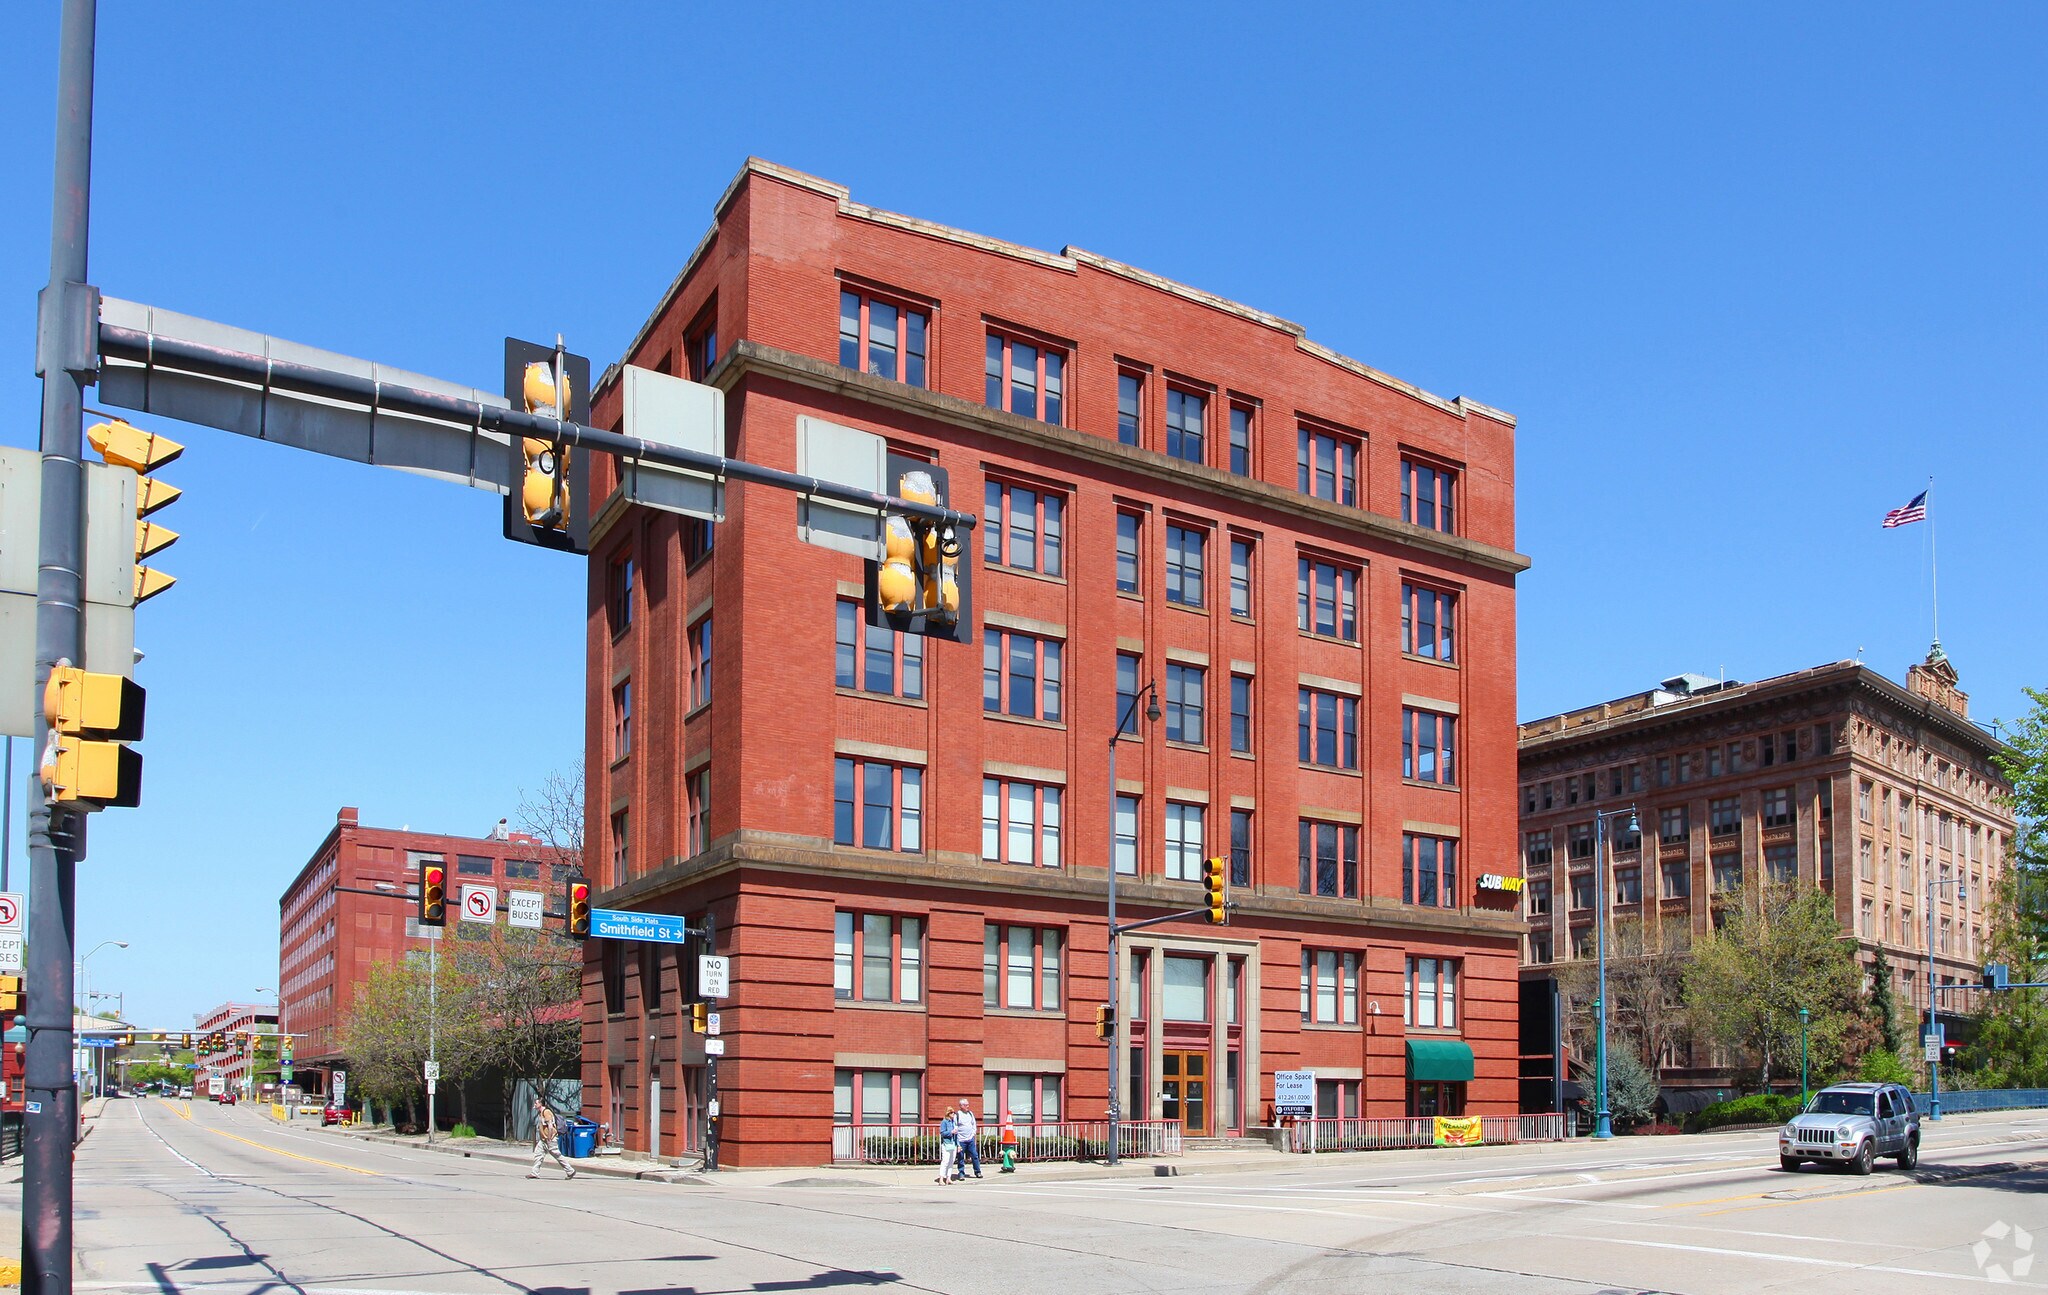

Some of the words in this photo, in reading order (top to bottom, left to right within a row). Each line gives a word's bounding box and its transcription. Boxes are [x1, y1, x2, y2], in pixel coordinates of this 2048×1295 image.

[1481, 873, 1525, 892] SUBWAY
[511, 897, 541, 909] EXCEPT
[512, 910, 539, 921] BUSES
[612, 914, 629, 922] South
[645, 917, 659, 925] Flats
[600, 922, 654, 938] Smithfield
[658, 927, 670, 939] St
[0, 940, 20, 950] EPT
[707, 960, 721, 969] NO
[706, 970, 723, 978] TURN
[427, 1070, 437, 1078] 35
[1295, 1073, 1311, 1081] Space
